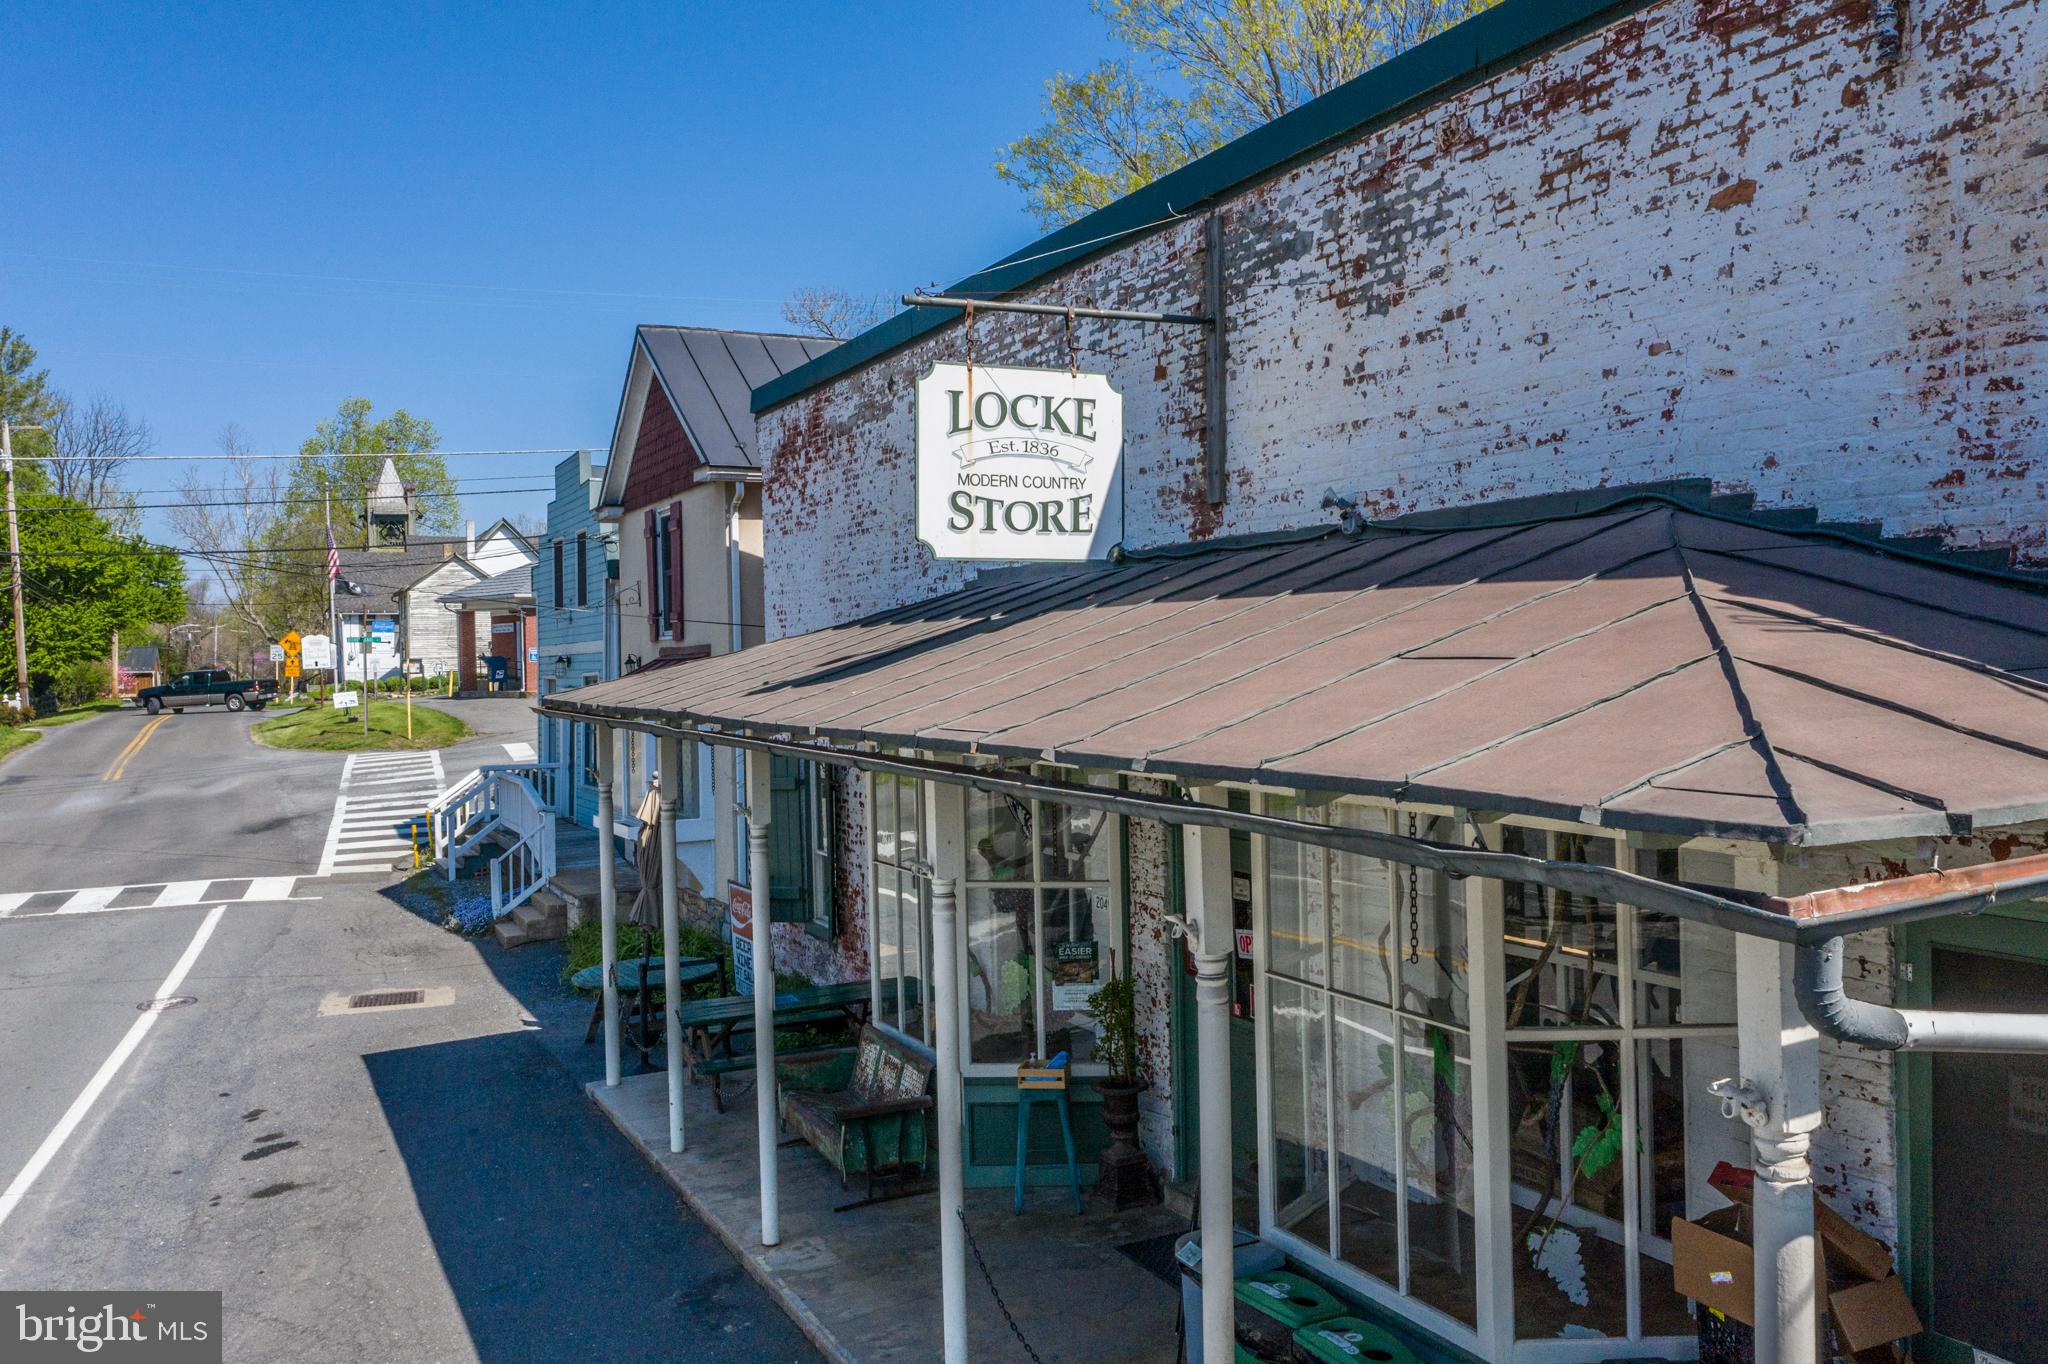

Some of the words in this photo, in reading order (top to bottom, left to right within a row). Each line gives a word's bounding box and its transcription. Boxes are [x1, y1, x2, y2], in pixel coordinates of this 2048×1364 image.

[946, 390, 1097, 442] LOCKE
[987, 441, 1019, 455] Est.
[1024, 440, 1059, 457] 1836
[957, 473, 1018, 488] MODERN
[1022, 475, 1087, 490] COUNTRY
[947, 490, 1093, 535] STORE
[1096, 896, 1109, 910] 204
[1058, 947, 1093, 956] EASIER
